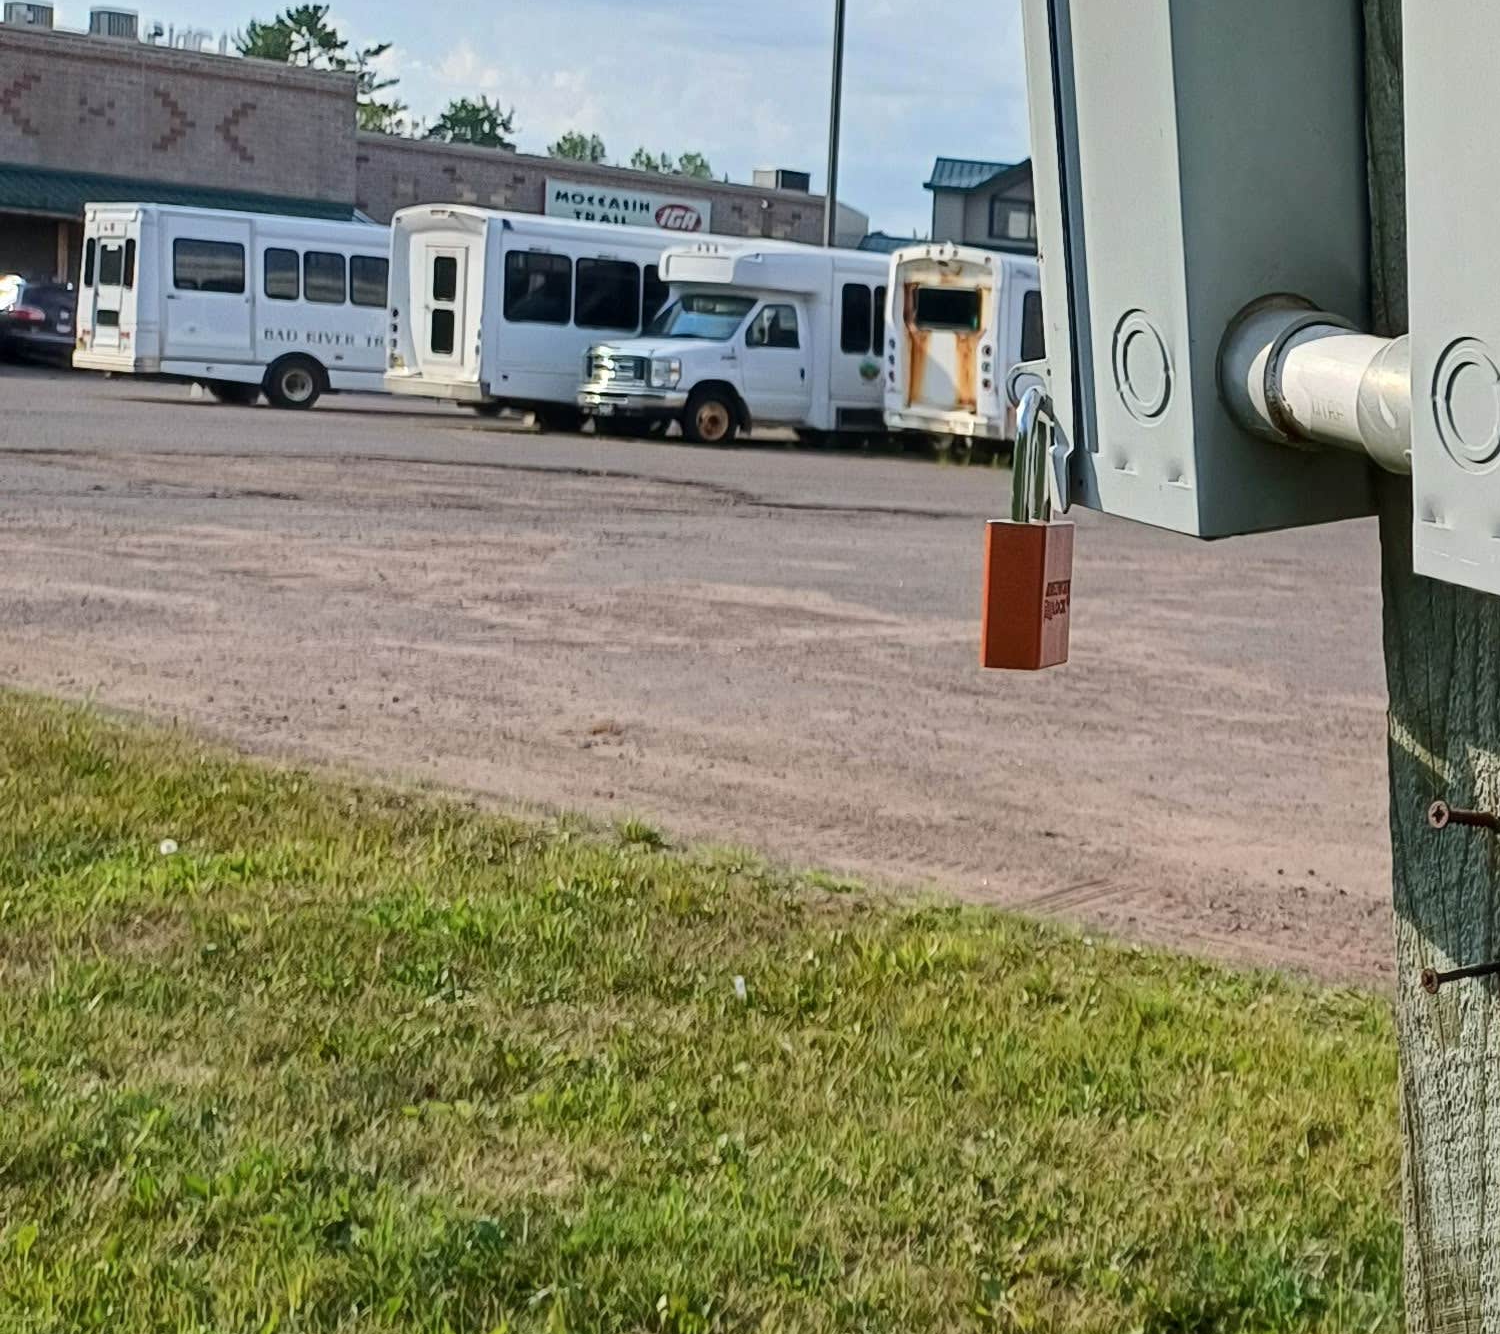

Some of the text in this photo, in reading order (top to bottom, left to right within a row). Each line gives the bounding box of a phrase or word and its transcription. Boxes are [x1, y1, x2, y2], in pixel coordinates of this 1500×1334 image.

[554, 190, 650, 213] MOCCASIN
[658, 206, 699, 231] IGA
[264, 328, 298, 342] BAD
[306, 331, 355, 346] RIVER
